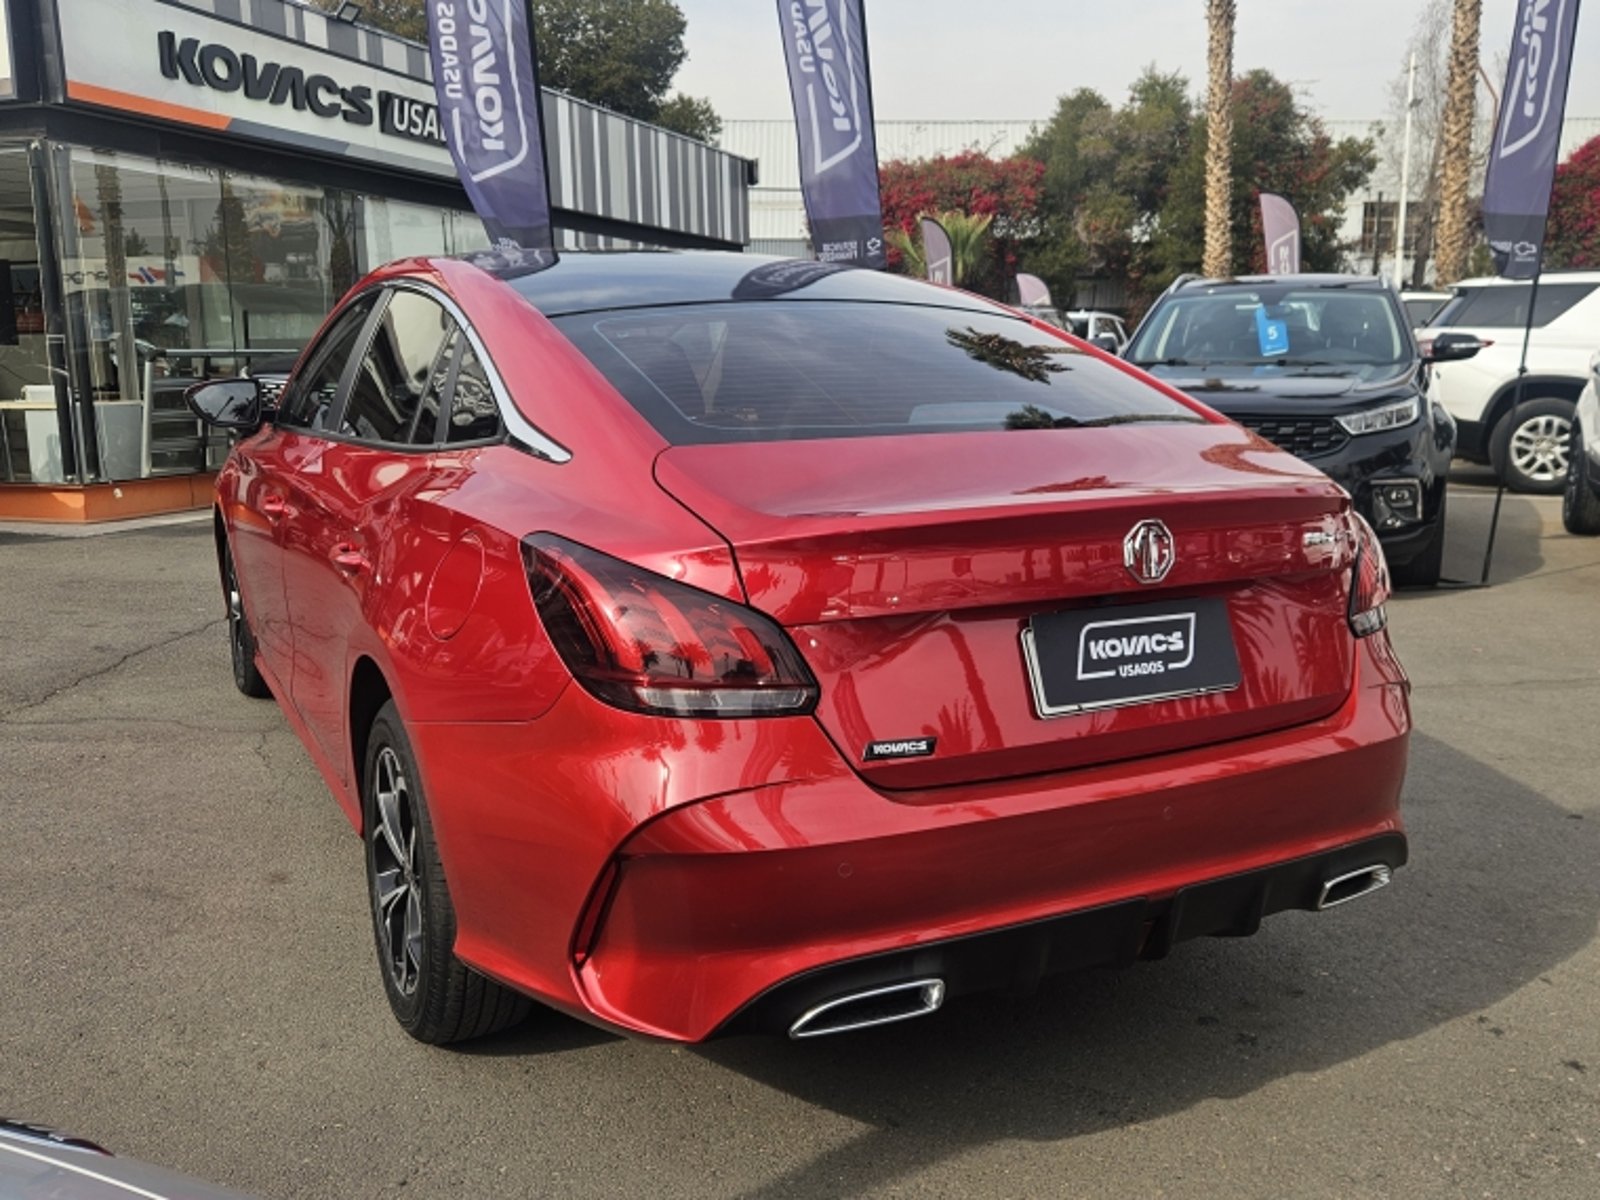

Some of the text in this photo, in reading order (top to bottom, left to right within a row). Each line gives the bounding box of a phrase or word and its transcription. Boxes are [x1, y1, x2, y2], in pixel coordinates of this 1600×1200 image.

[158, 31, 447, 141] KOVACS USA
[1125, 523, 1172, 579] MG
[1089, 631, 1184, 660] KOVACS
[1118, 660, 1165, 678] USADOS
[873, 740, 927, 754] KOVACS
